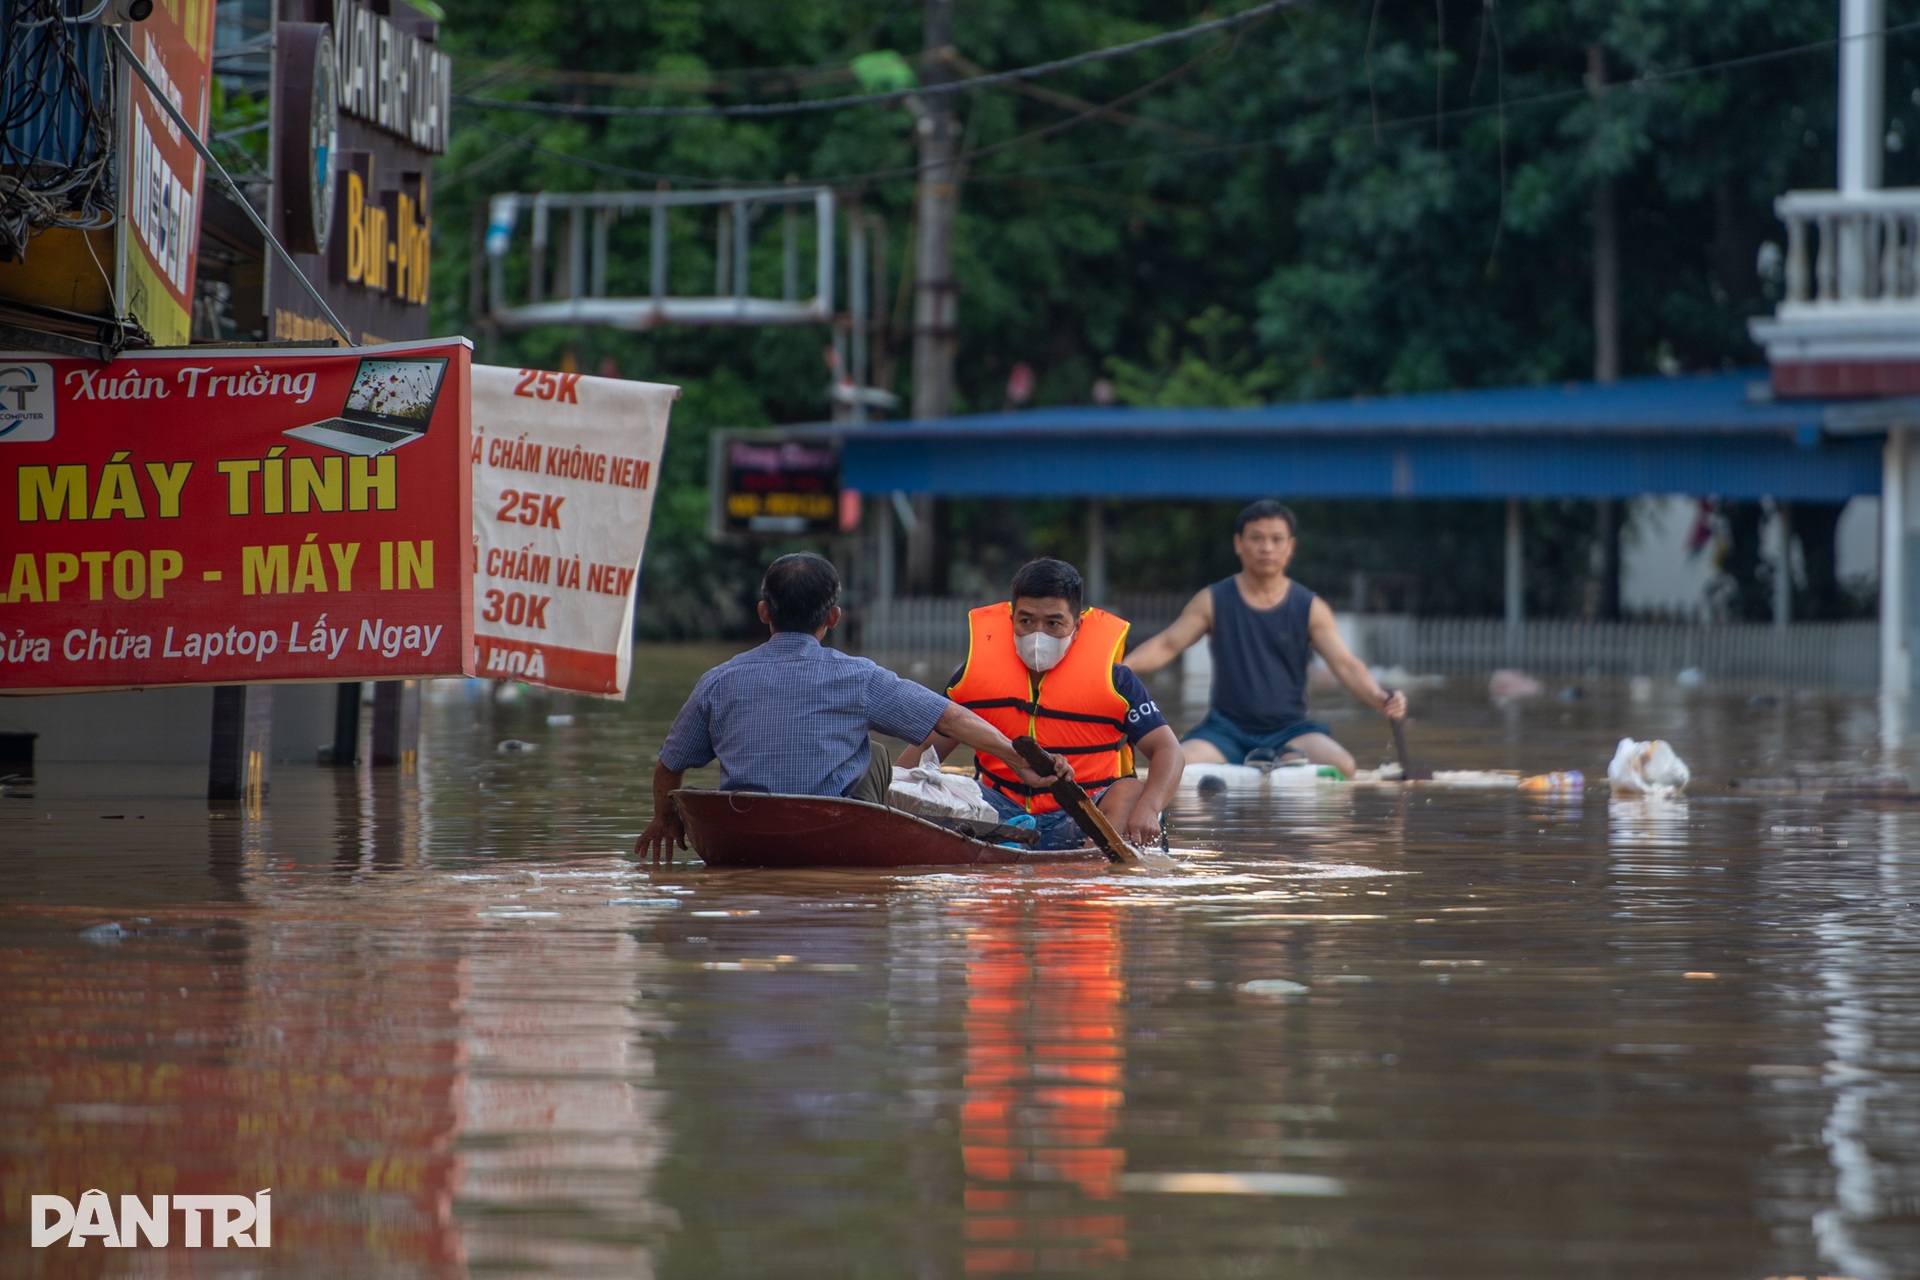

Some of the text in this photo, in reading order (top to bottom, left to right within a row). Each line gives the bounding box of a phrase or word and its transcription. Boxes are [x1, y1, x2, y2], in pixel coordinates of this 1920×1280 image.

[64, 365, 317, 403] Xuân Trường
[514, 368, 582, 404] 25K
[17, 446, 397, 521] MÁY TÍNH
[488, 432, 542, 475] CHẤM
[545, 445, 606, 483] KHÔNG
[609, 456, 651, 490] NEM
[496, 489, 565, 529] 25K
[0, 549, 184, 603] APTOP
[242, 533, 361, 595] MÁY
[379, 540, 434, 590] IN
[486, 543, 551, 584] CHẤM
[557, 554, 581, 590] VÀ
[586, 563, 635, 597] NEM
[482, 588, 551, 629] 30K
[63, 628, 152, 661] Chữa
[163, 625, 278, 664] Laptop
[288, 613, 349, 660] Lấy
[357, 619, 443, 658] Ngay
[486, 648, 546, 679] HOÀ
